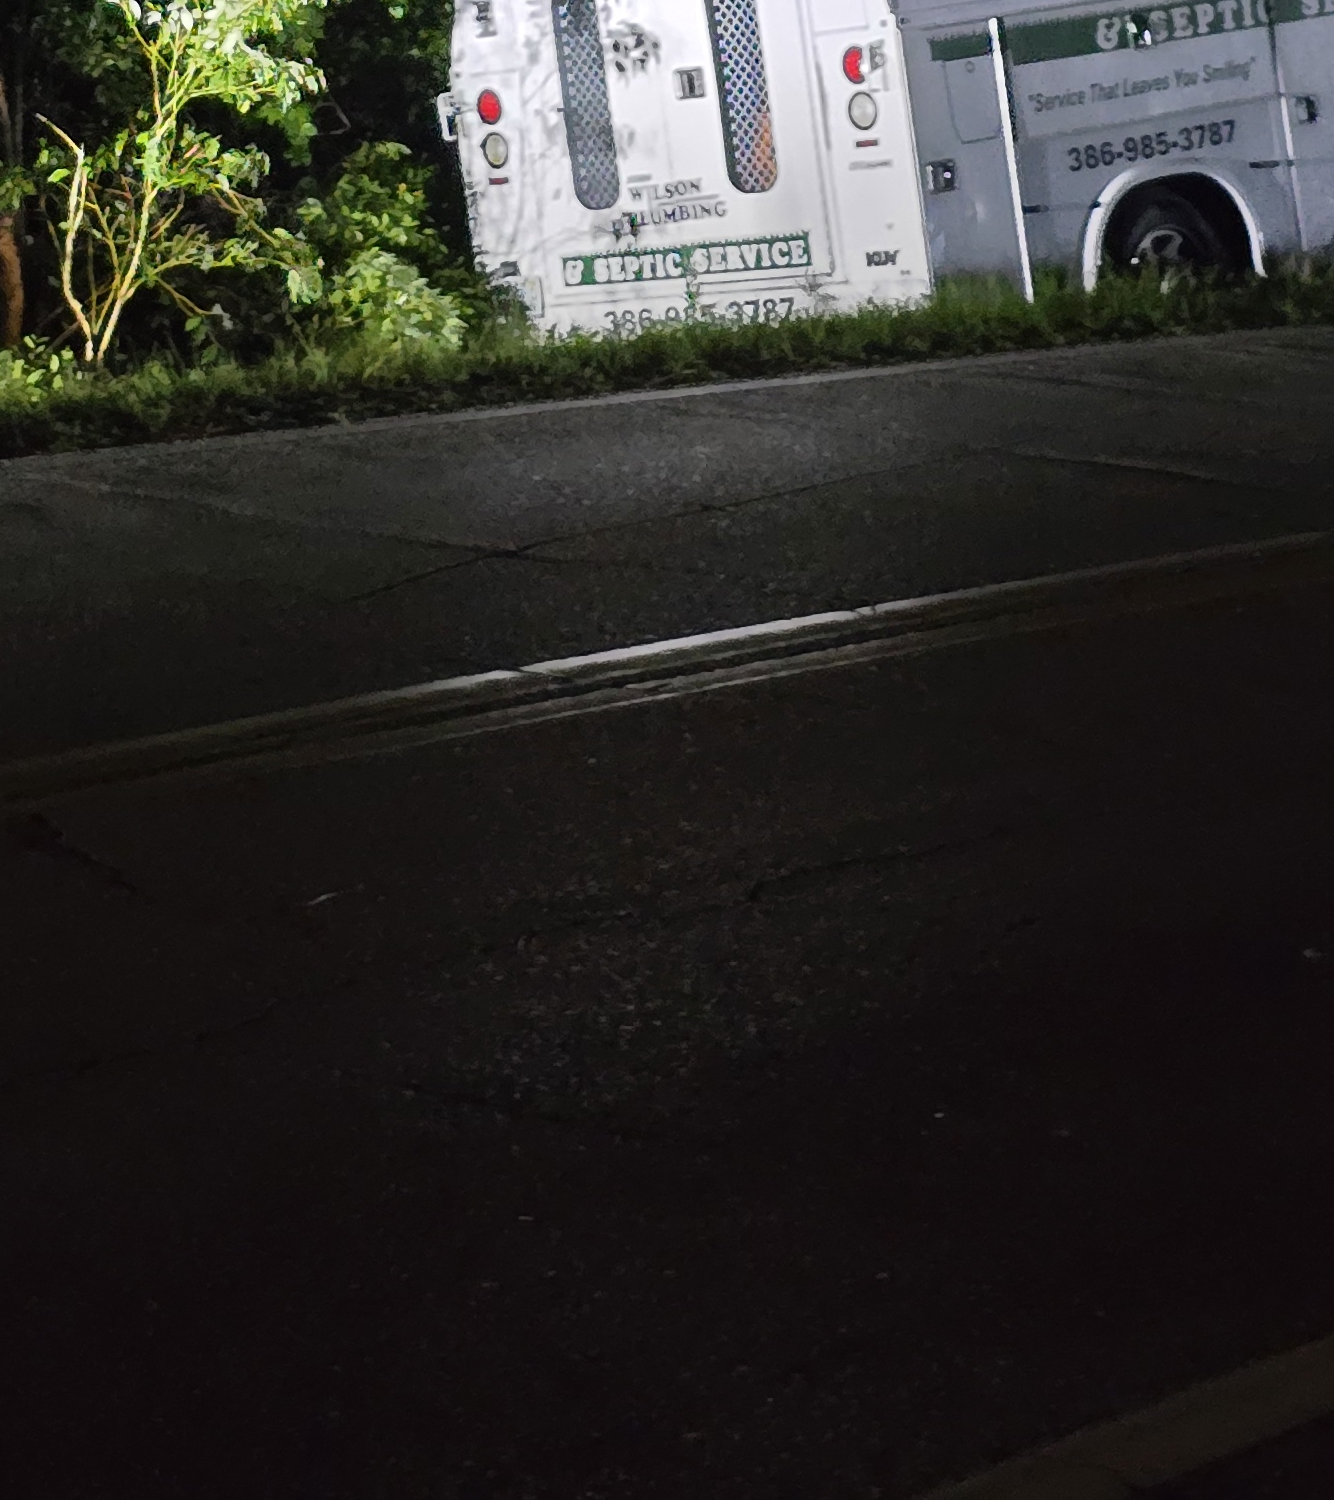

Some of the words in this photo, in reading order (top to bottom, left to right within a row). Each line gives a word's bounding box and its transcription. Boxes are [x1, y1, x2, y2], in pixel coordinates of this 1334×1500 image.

[1096, 17, 1121, 50] &
[1068, 119, 1236, 172] 386-985-3787
[629, 180, 702, 200] WLSON
[622, 201, 727, 230] LUMBING
[593, 250, 683, 283] SEPTIC
[690, 239, 809, 274] SERVICE
[604, 297, 795, 336] 386983787
